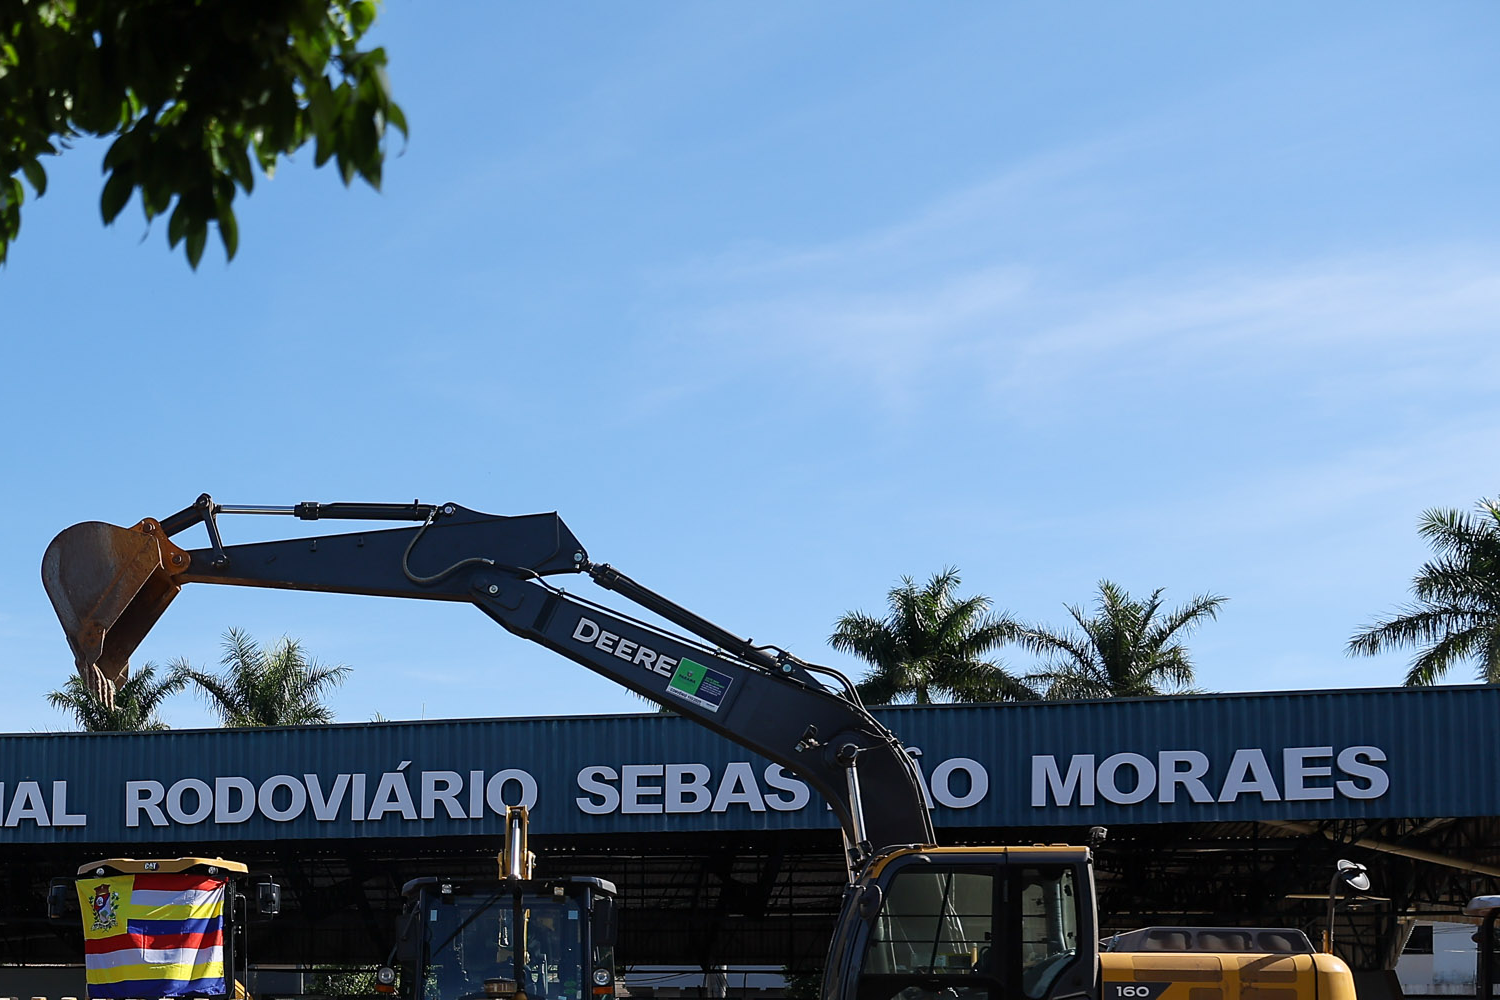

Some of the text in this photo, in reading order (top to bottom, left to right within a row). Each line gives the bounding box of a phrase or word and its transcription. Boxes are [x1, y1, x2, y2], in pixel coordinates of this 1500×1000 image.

[572, 617, 678, 678] DEERE
[125, 760, 539, 827] RODOVIÁRIO
[575, 747, 989, 815] SEBASO
[1031, 746, 1390, 807] MORAES
[1116, 986, 1150, 997] 160
